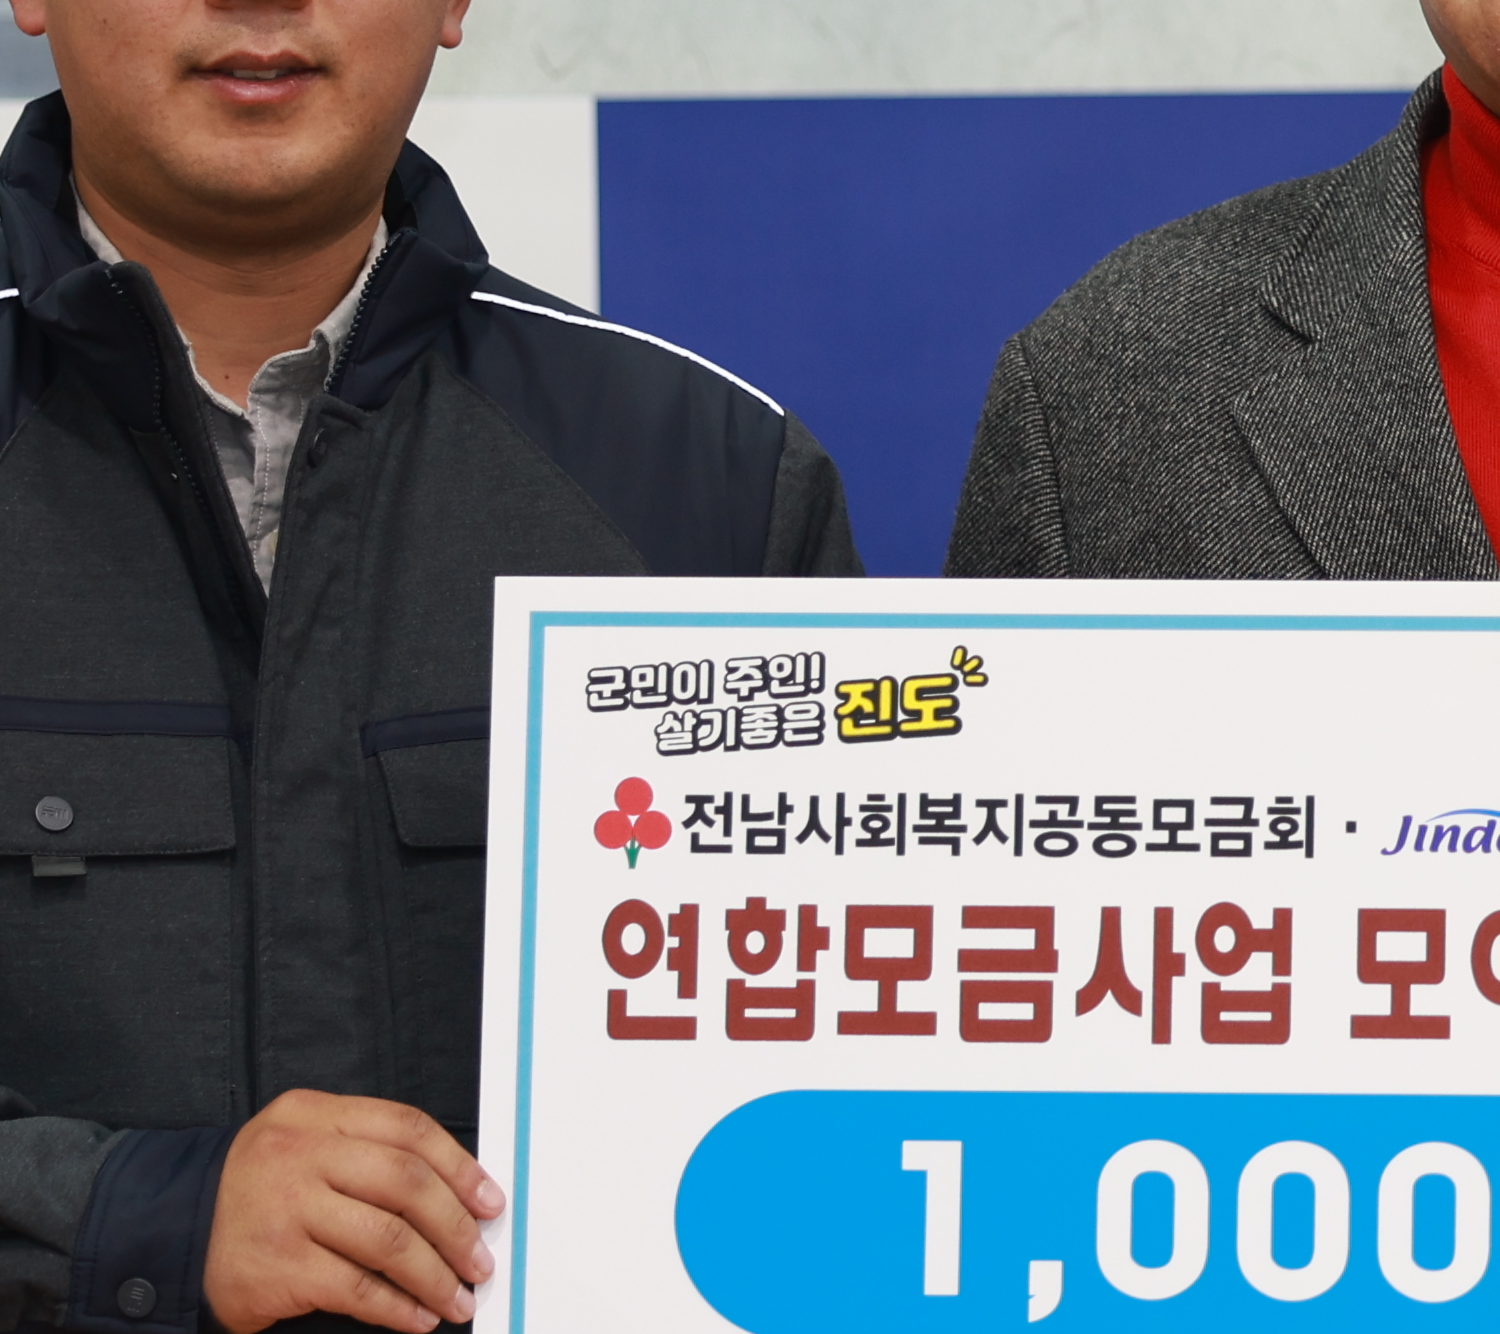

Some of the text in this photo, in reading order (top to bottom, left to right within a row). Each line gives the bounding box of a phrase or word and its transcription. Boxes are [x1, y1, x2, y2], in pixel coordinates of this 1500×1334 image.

[586, 651, 827, 713] 군민이 주인!
[654, 672, 963, 757] 살기좋은 진도
[680, 791, 1315, 859] 전남사회복지공동모금회
[603, 897, 1292, 1045] 연합모금사업
